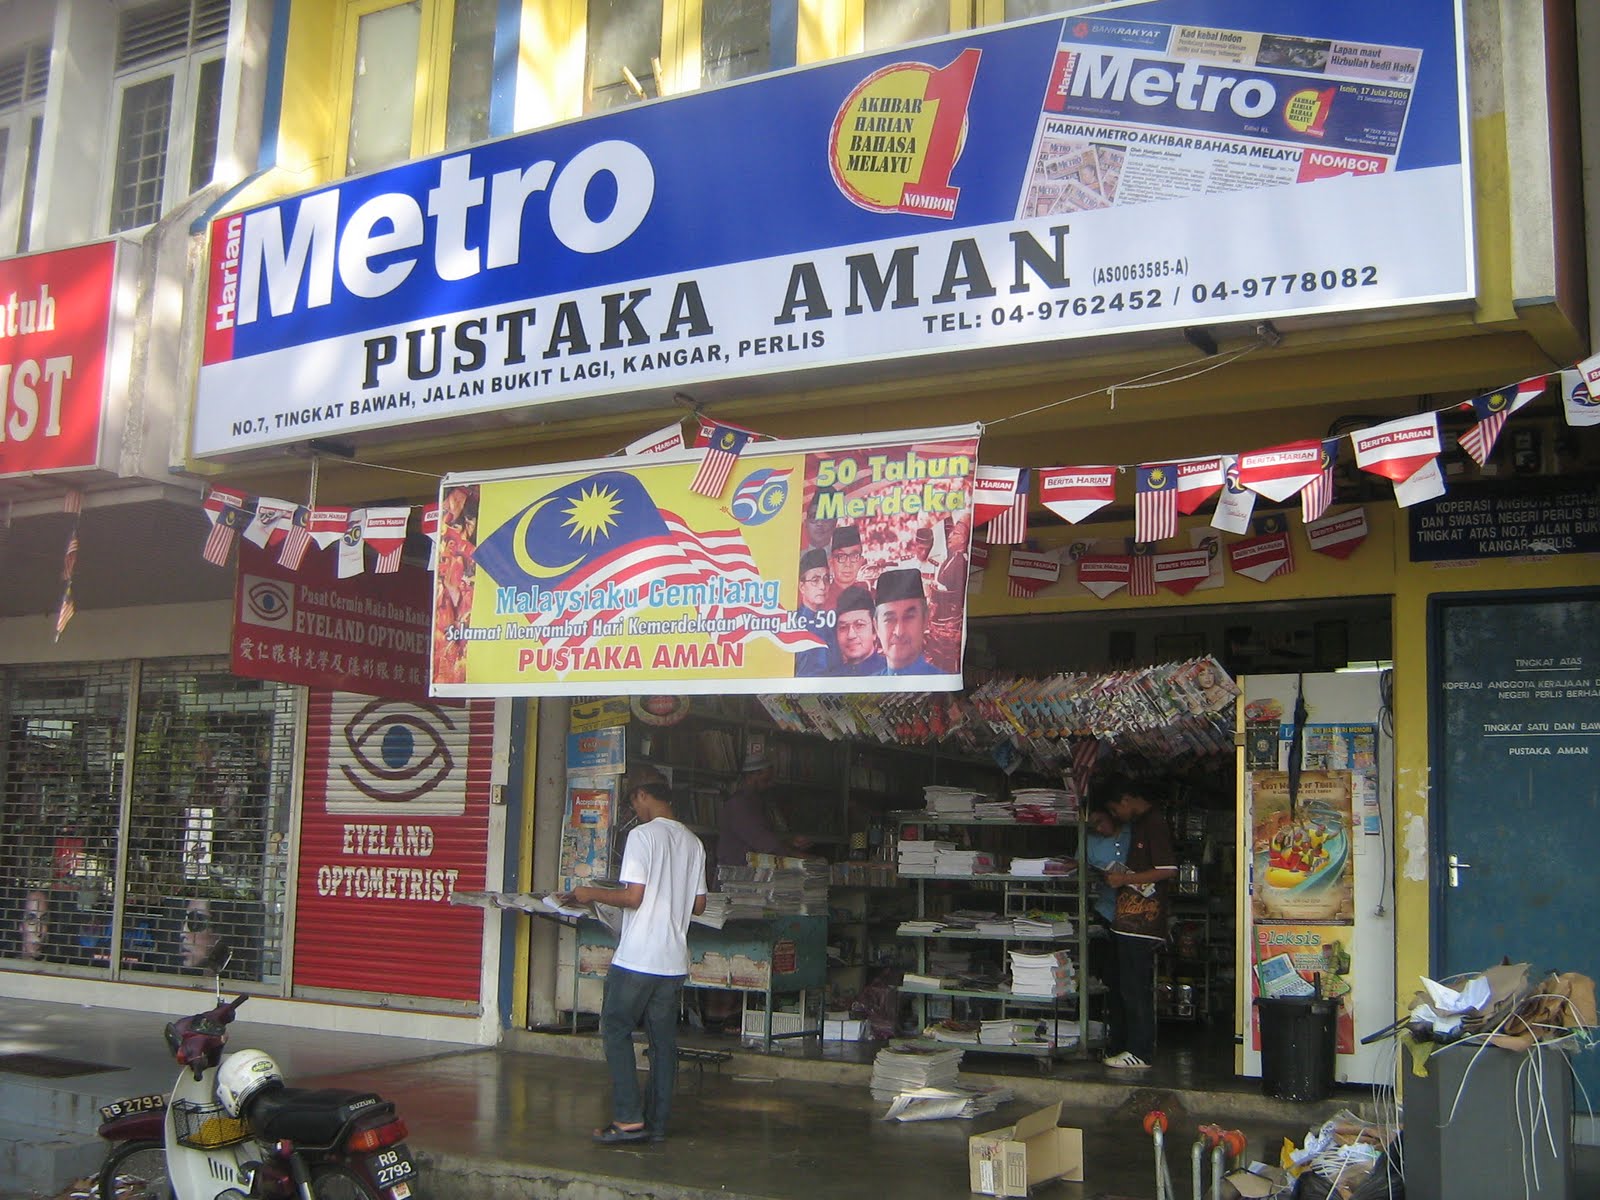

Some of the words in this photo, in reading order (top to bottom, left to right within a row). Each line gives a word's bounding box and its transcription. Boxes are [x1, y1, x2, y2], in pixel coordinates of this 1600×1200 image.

[1180, 28, 1196, 39] Kad
[1197, 30, 1219, 41] kebal
[1219, 32, 1243, 44] Indon
[1333, 44, 1358, 57] Lapan
[1359, 47, 1382, 58] maut
[1057, 51, 1078, 96] Harian
[1330, 56, 1369, 69] Hizbullah
[1370, 60, 1392, 71] bedil
[1070, 51, 1277, 119] Metro
[1399, 74, 1413, 83] 27
[1360, 87, 1370, 95] 17
[1388, 90, 1408, 100] 2006
[858, 97, 923, 114] AKHBAR
[853, 116, 915, 133] HARIAN
[849, 135, 917, 154] BAHASA
[1046, 122, 1096, 138] HARIAN
[1095, 127, 1139, 142] METRO
[1139, 133, 1194, 149] AKHBAR
[1194, 140, 1249, 157] BAHASA
[1249, 146, 1303, 163] MELAYU
[845, 154, 913, 174] MELAYU
[1308, 152, 1380, 173] NOMBOR
[901, 192, 955, 212] NOMBOR
[236, 139, 655, 326] Metro
[215, 216, 243, 331] Harian
[1092, 256, 1189, 287] (AS0063585-A)
[362, 279, 714, 390] PUSTAKA
[774, 224, 1071, 325] AMAN
[923, 313, 982, 335] TEL:
[990, 287, 1163, 328] 04-9762452
[1191, 264, 1379, 304] 04-9778082
[232, 417, 270, 437] NO.7,
[274, 404, 344, 429] TINGKAT
[349, 391, 416, 417] BAWAH,
[422, 380, 485, 404] JALAN
[490, 368, 552, 394] BUKIT
[559, 360, 615, 383] LAGI,
[621, 343, 730, 375] KANGAR,
[738, 329, 826, 357] PERLIS
[655, 437, 680, 453] HARIAN
[1360, 435, 1392, 451] BERITA
[1393, 427, 1433, 442] HARIAN
[1183, 461, 1218, 475] HARIAN
[1246, 454, 1277, 467] BERITA
[1278, 449, 1316, 463] HARIAN
[815, 457, 859, 489] 50
[868, 450, 972, 482] Tahun
[980, 479, 1013, 490] HARIAN
[1047, 476, 1075, 487] BERITA
[1076, 475, 1110, 485] HARIAN
[814, 484, 967, 521] Merdeka
[1435, 500, 1491, 514] KOPERASI
[1496, 496, 1551, 511] ANGGOTA
[386, 517, 405, 526] HARIAN
[1421, 516, 1444, 529] DAN
[1449, 514, 1494, 527] SWASTA
[1498, 510, 1539, 524] NEGERI
[1543, 507, 1583, 520] PERLIS
[1417, 529, 1464, 543] TINGKAT
[1469, 527, 1497, 539] ATAS
[1532, 522, 1570, 536] JALAN
[1256, 541, 1284, 553] HARIAN
[1479, 539, 1529, 553] KANGAR
[300, 585, 329, 607] Pusat
[330, 590, 364, 614] Cermin
[364, 598, 387, 618] Mata
[387, 602, 405, 621] Dan
[495, 580, 640, 617] Malaysiaku
[648, 577, 780, 610] Gemilang
[296, 611, 365, 644] EYELAND
[446, 622, 502, 642] Selamat
[506, 620, 589, 643] Menyambut
[592, 618, 624, 638] Hari
[628, 613, 738, 635] Kemerdekaan
[741, 612, 781, 634] Yang
[785, 609, 838, 631] Ke-50
[518, 645, 643, 673] PUSTAKA
[651, 641, 744, 670] AMAN
[1515, 658, 1554, 667] TINGKAT
[1559, 657, 1583, 666] ATAS
[1442, 681, 1483, 690] KOPERASI
[1488, 680, 1536, 689] ANGGOTA
[1538, 679, 1590, 688] KERAJAAN
[1498, 690, 1530, 699] NEGERI
[1535, 690, 1564, 699] PERLIS
[1483, 723, 1523, 732] TINGKAT
[1527, 723, 1549, 731] SATU
[1554, 722, 1575, 730] DAN
[1508, 747, 1552, 756] PUSTAKA
[1556, 746, 1589, 755] AMAN
[342, 824, 435, 857] EYELAND
[317, 864, 459, 902] OPTOMETRIST
[1258, 930, 1322, 947] eleksis
[101, 1103, 123, 1119] RB
[123, 1094, 164, 1114] 2793
[349, 1098, 377, 1111] SUZUKI
[378, 1150, 399, 1167] RB
[377, 1160, 412, 1183] 2793
